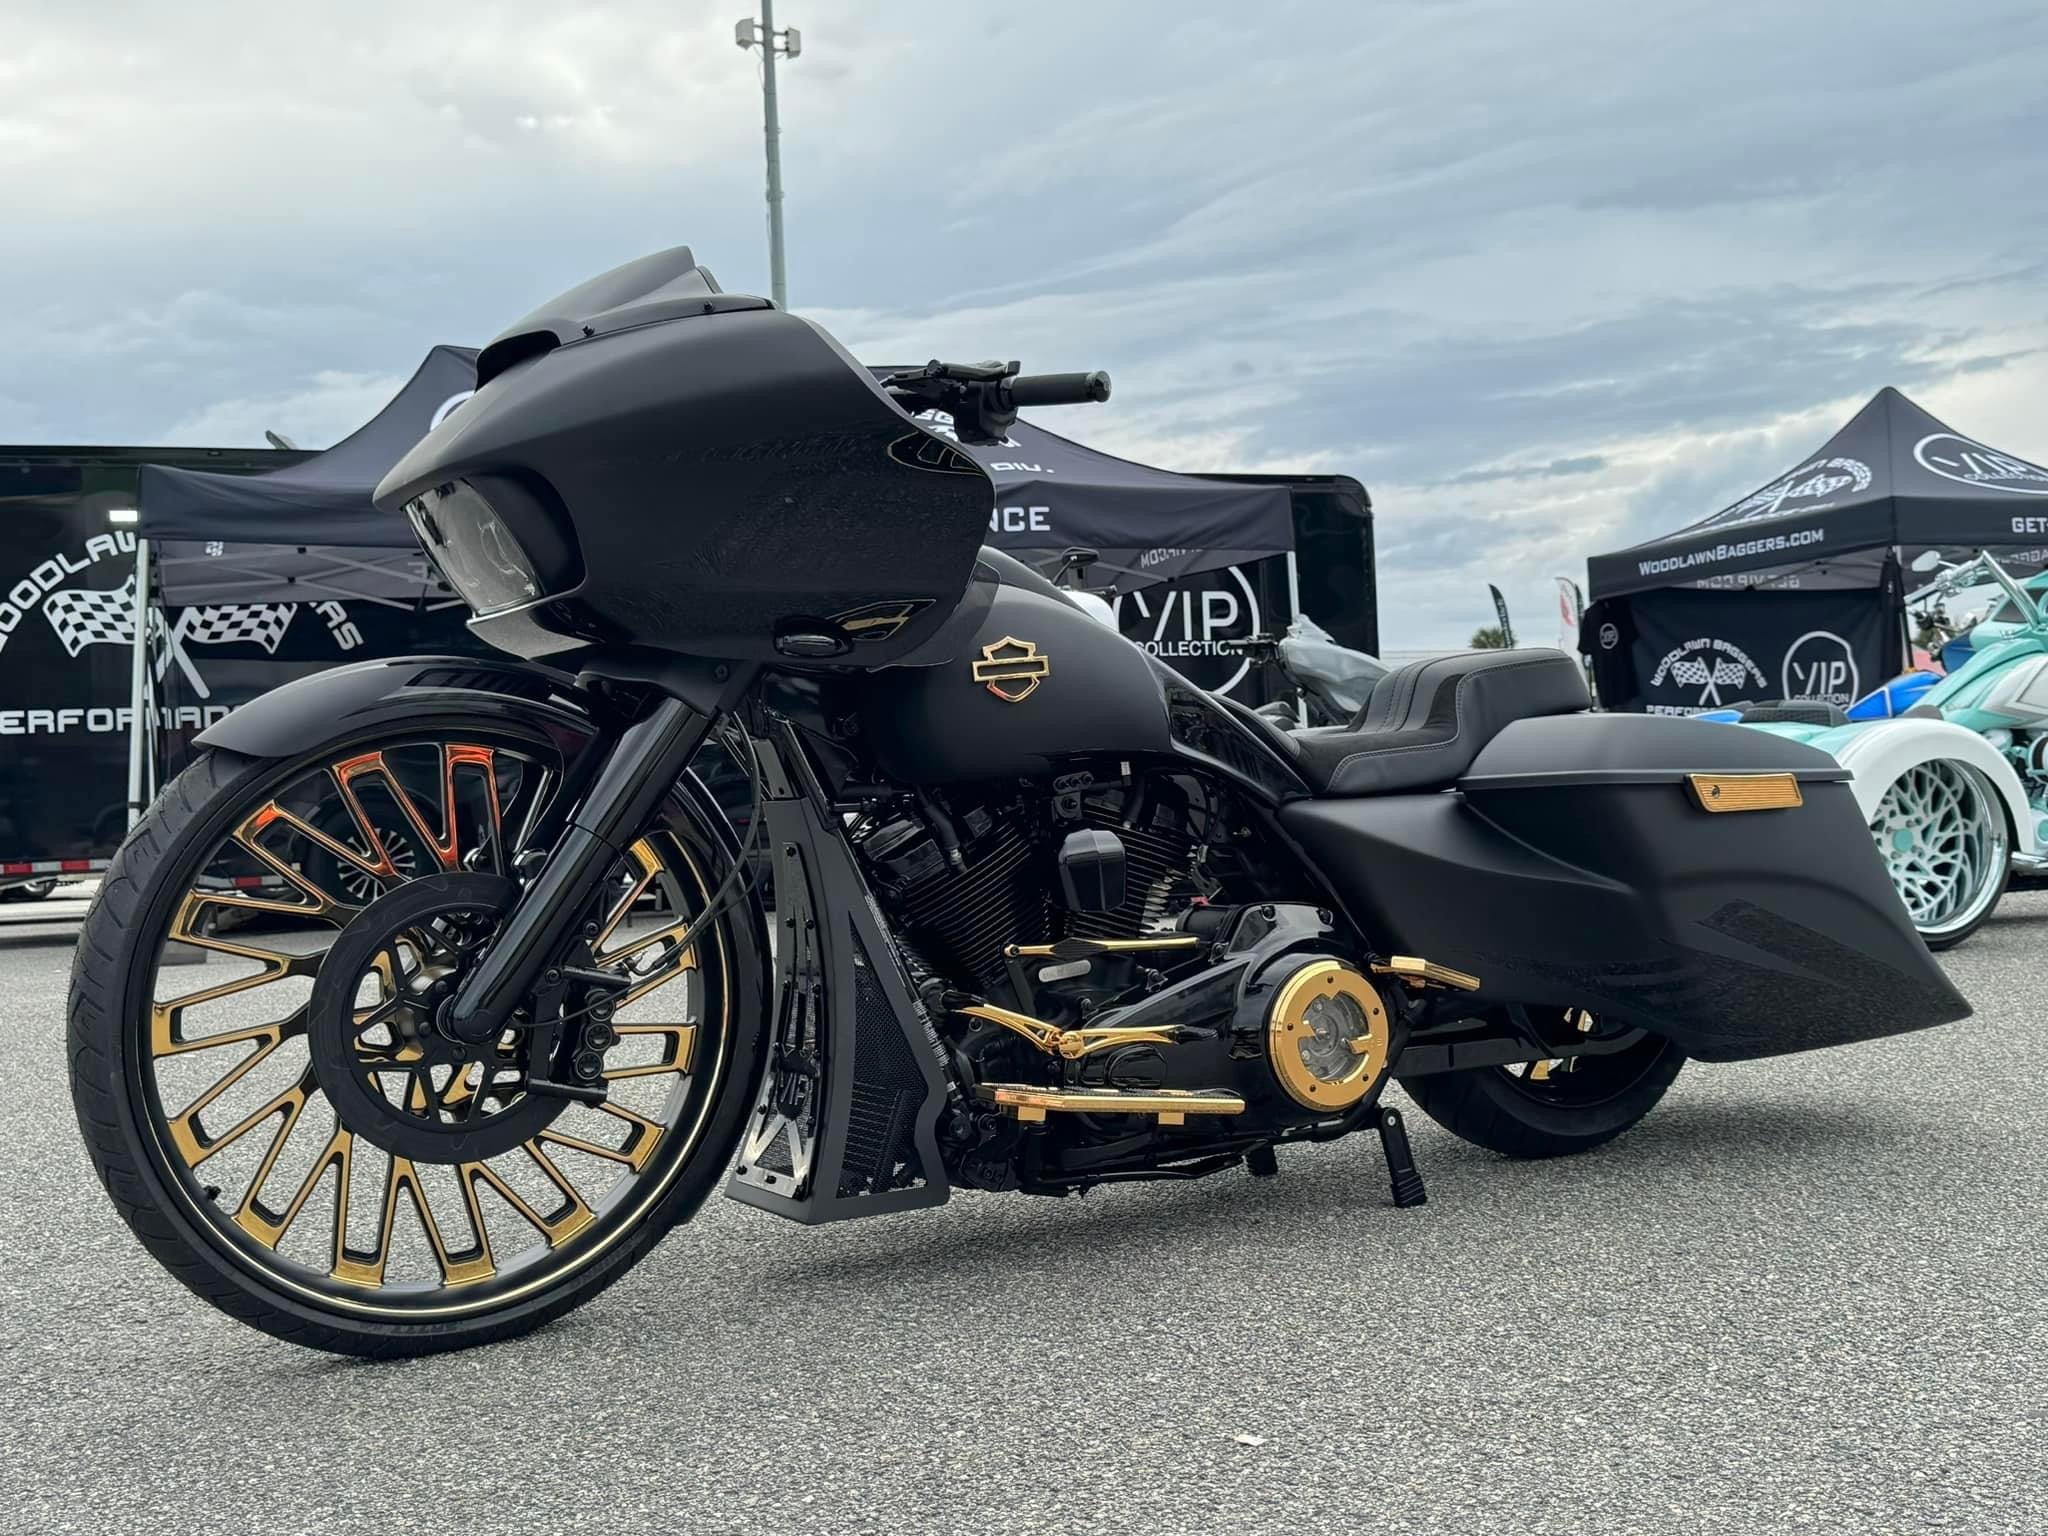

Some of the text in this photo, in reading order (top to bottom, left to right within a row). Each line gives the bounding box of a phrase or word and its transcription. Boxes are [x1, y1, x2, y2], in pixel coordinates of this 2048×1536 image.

[0, 530, 137, 653] OODLAW
[1133, 590, 1238, 642] VIP
[1649, 637, 1711, 687] WOODLAWN
[1792, 660, 1847, 695] VIP
